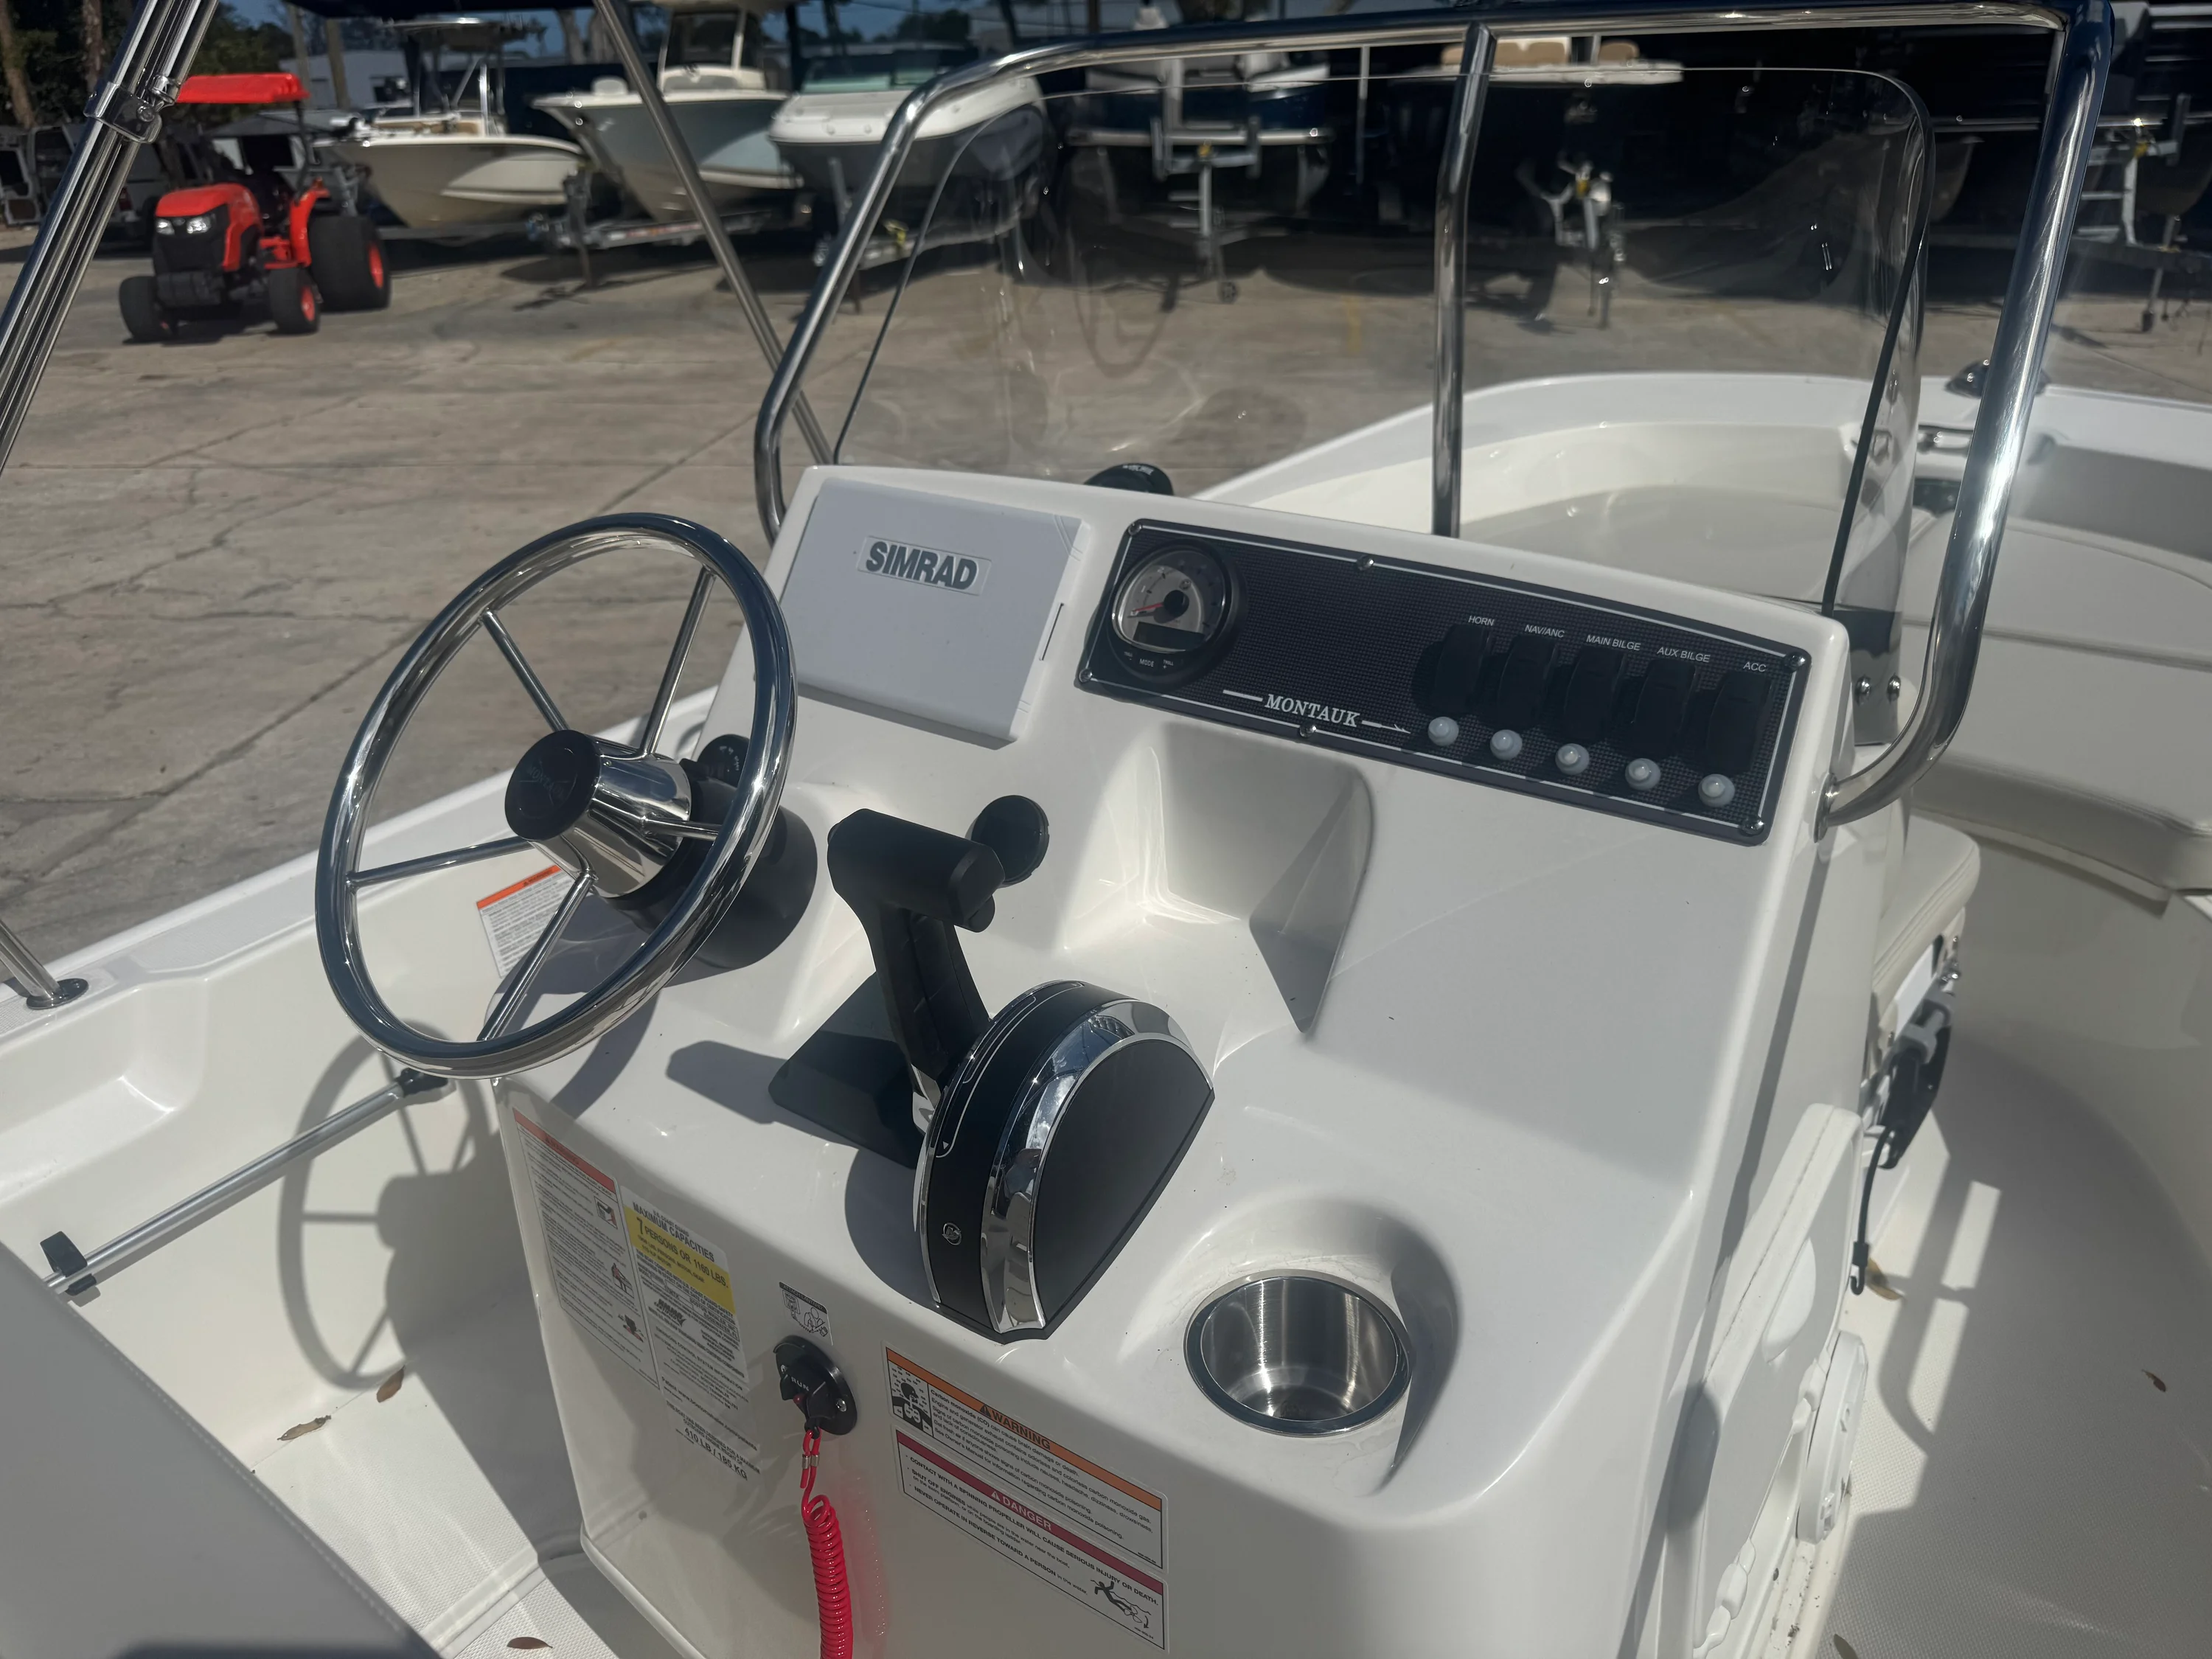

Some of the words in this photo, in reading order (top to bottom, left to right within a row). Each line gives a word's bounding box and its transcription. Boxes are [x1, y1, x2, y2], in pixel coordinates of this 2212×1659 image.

[866, 541, 978, 591] SIMRAD
[1468, 615, 1495, 627] HORN
[1525, 625, 1565, 639] NAV/ANC
[1139, 658, 1155, 667] MODE
[1586, 635, 1611, 647] MAIN
[1612, 639, 1641, 651] BILGE
[1657, 647, 1680, 658] AUX
[1680, 650, 1711, 663] BILGE
[1743, 661, 1767, 672] ACC
[1265, 694, 1360, 727] MONTAUK
[632, 1200, 668, 1233] MAXIMUM
[668, 1224, 714, 1264] CAPACITIES
[636, 1216, 646, 1237] 7
[644, 1224, 679, 1256] PERSONS
[678, 1247, 692, 1265] OR
[692, 1256, 710, 1277] 1160
[709, 1267, 729, 1290] LBS.
[791, 1377, 810, 1391] RUN
[930, 1388, 950, 1405] Carbon
[950, 1400, 976, 1419] monoxide
[976, 1415, 990, 1427] (CO)
[990, 1424, 1000, 1433] can
[1001, 1430, 1017, 1443] cause
[1018, 1439, 1031, 1450] brain
[1032, 1447, 1054, 1464] damage
[1062, 1463, 1079, 1478] death.
[932, 1411, 942, 1421] and
[942, 1416, 953, 1427] lack
[991, 1409, 1051, 1450] WARNING
[683, 1425, 699, 1444] 410
[699, 1437, 712, 1454] LB
[717, 1450, 732, 1470] 185
[733, 1462, 748, 1482] KG
[931, 1396, 948, 1411] Engine
[949, 1407, 959, 1417] and
[959, 1413, 984, 1432] generator
[984, 1427, 1004, 1443] exhaust
[1004, 1439, 1026, 1456] contains
[1027, 1452, 1051, 1470] odorless
[1051, 1465, 1062, 1475] and
[1062, 1472, 1088, 1490] colorless
[1088, 1486, 1109, 1502] carbon
[1109, 1496, 1138, 1517] monoxide
[1138, 1513, 1151, 1525] gas.
[932, 1405, 946, 1418] Signs
[946, 1413, 952, 1421] of
[952, 1416, 969, 1431] carbon
[970, 1427, 994, 1445] monoxide
[994, 1441, 1020, 1461] poisoning
[1020, 1455, 1039, 1471] include
[1091, 1495, 1118, 1515] dizziness,
[1119, 1510, 1152, 1534] drowsiness,
[984, 1449, 1000, 1461] shows
[1020, 1469, 1038, 1484] carbon
[1038, 1480, 1064, 1499] monoxide
[911, 1467, 927, 1482] SHUT
[927, 1478, 939, 1489] OFF
[939, 1486, 966, 1506] ENGINES
[1002, 1495, 1051, 1531] DANGER
[1021, 1478, 1046, 1497] regarding
[1046, 1492, 1065, 1507] carbon
[1067, 1503, 1093, 1523] monoxide
[1094, 1519, 1123, 1540] poisoning.
[909, 1455, 936, 1477] CONTACT
[936, 1472, 953, 1486] WITH
[958, 1486, 987, 1508] SPINNING
[988, 1503, 1025, 1530] PROPELLER
[1026, 1526, 1041, 1540] WILL
[1042, 1535, 1065, 1553] CAUSE
[1065, 1548, 1095, 1571] SERIOUS
[1096, 1565, 1120, 1585] INJURY
[1121, 1580, 1133, 1591] OR
[1133, 1587, 1158, 1607] DEATH.
[914, 1485, 933, 1501] NEVER
[933, 1497, 961, 1519] OPERATE
[960, 1514, 967, 1523] IN
[967, 1519, 995, 1540] REVERSE
[996, 1537, 1023, 1557] TOWARD
[1029, 1557, 1056, 1576] PERSON
